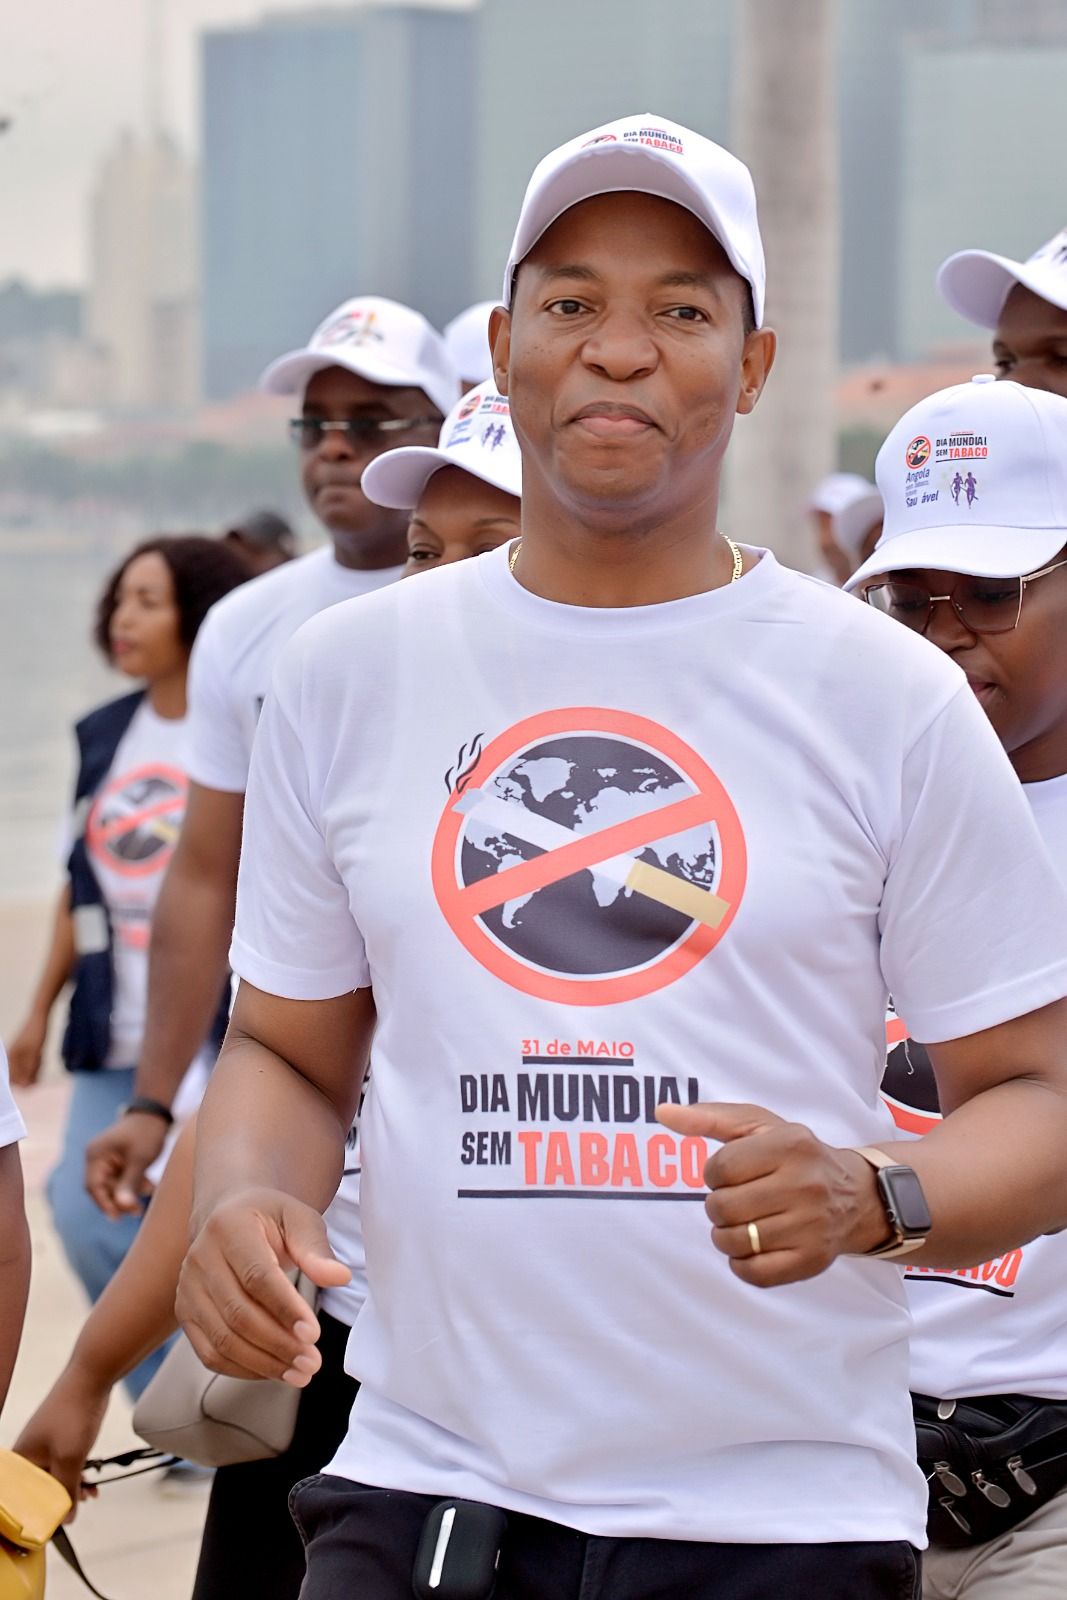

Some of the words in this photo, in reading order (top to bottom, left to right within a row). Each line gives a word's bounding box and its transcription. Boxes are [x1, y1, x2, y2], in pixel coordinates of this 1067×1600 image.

[639, 130, 683, 145] MUNDIAL
[936, 438, 948, 447] DIA
[936, 449, 947, 457] SEM
[948, 447, 988, 458] TABACO
[906, 468, 930, 483] Angola
[521, 1039, 540, 1055] 31
[546, 1039, 571, 1055] de
[577, 1040, 635, 1057] MAIO
[460, 1074, 510, 1113] DIA
[460, 1131, 511, 1165] SEM
[518, 1131, 708, 1188] TABACO
